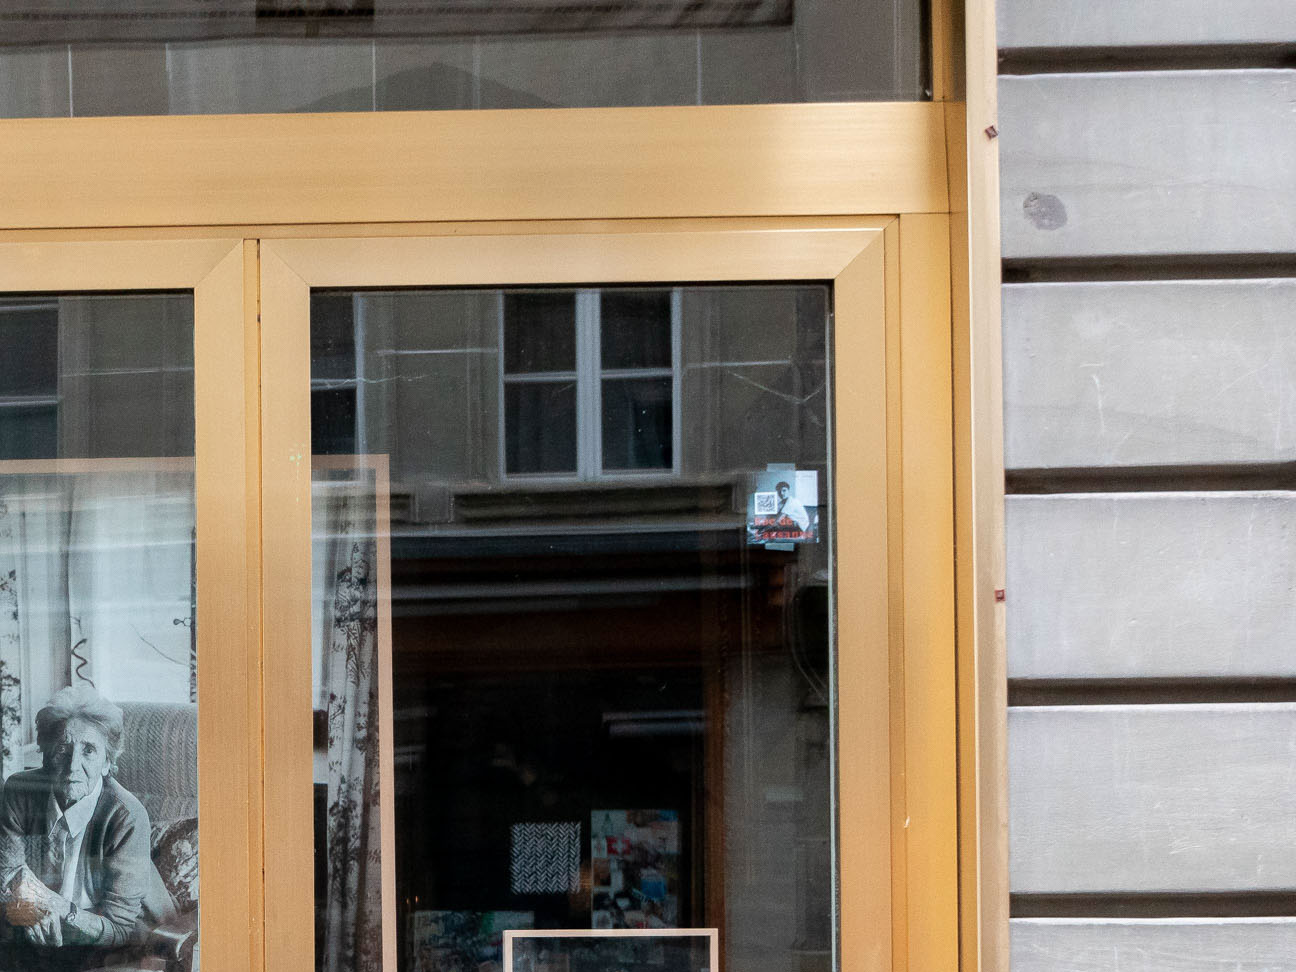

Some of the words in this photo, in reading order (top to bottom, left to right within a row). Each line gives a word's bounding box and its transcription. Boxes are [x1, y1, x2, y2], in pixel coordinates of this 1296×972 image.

[754, 517, 775, 526] Rue
[778, 516, 793, 526] de
[754, 529, 814, 540] Lausanne
